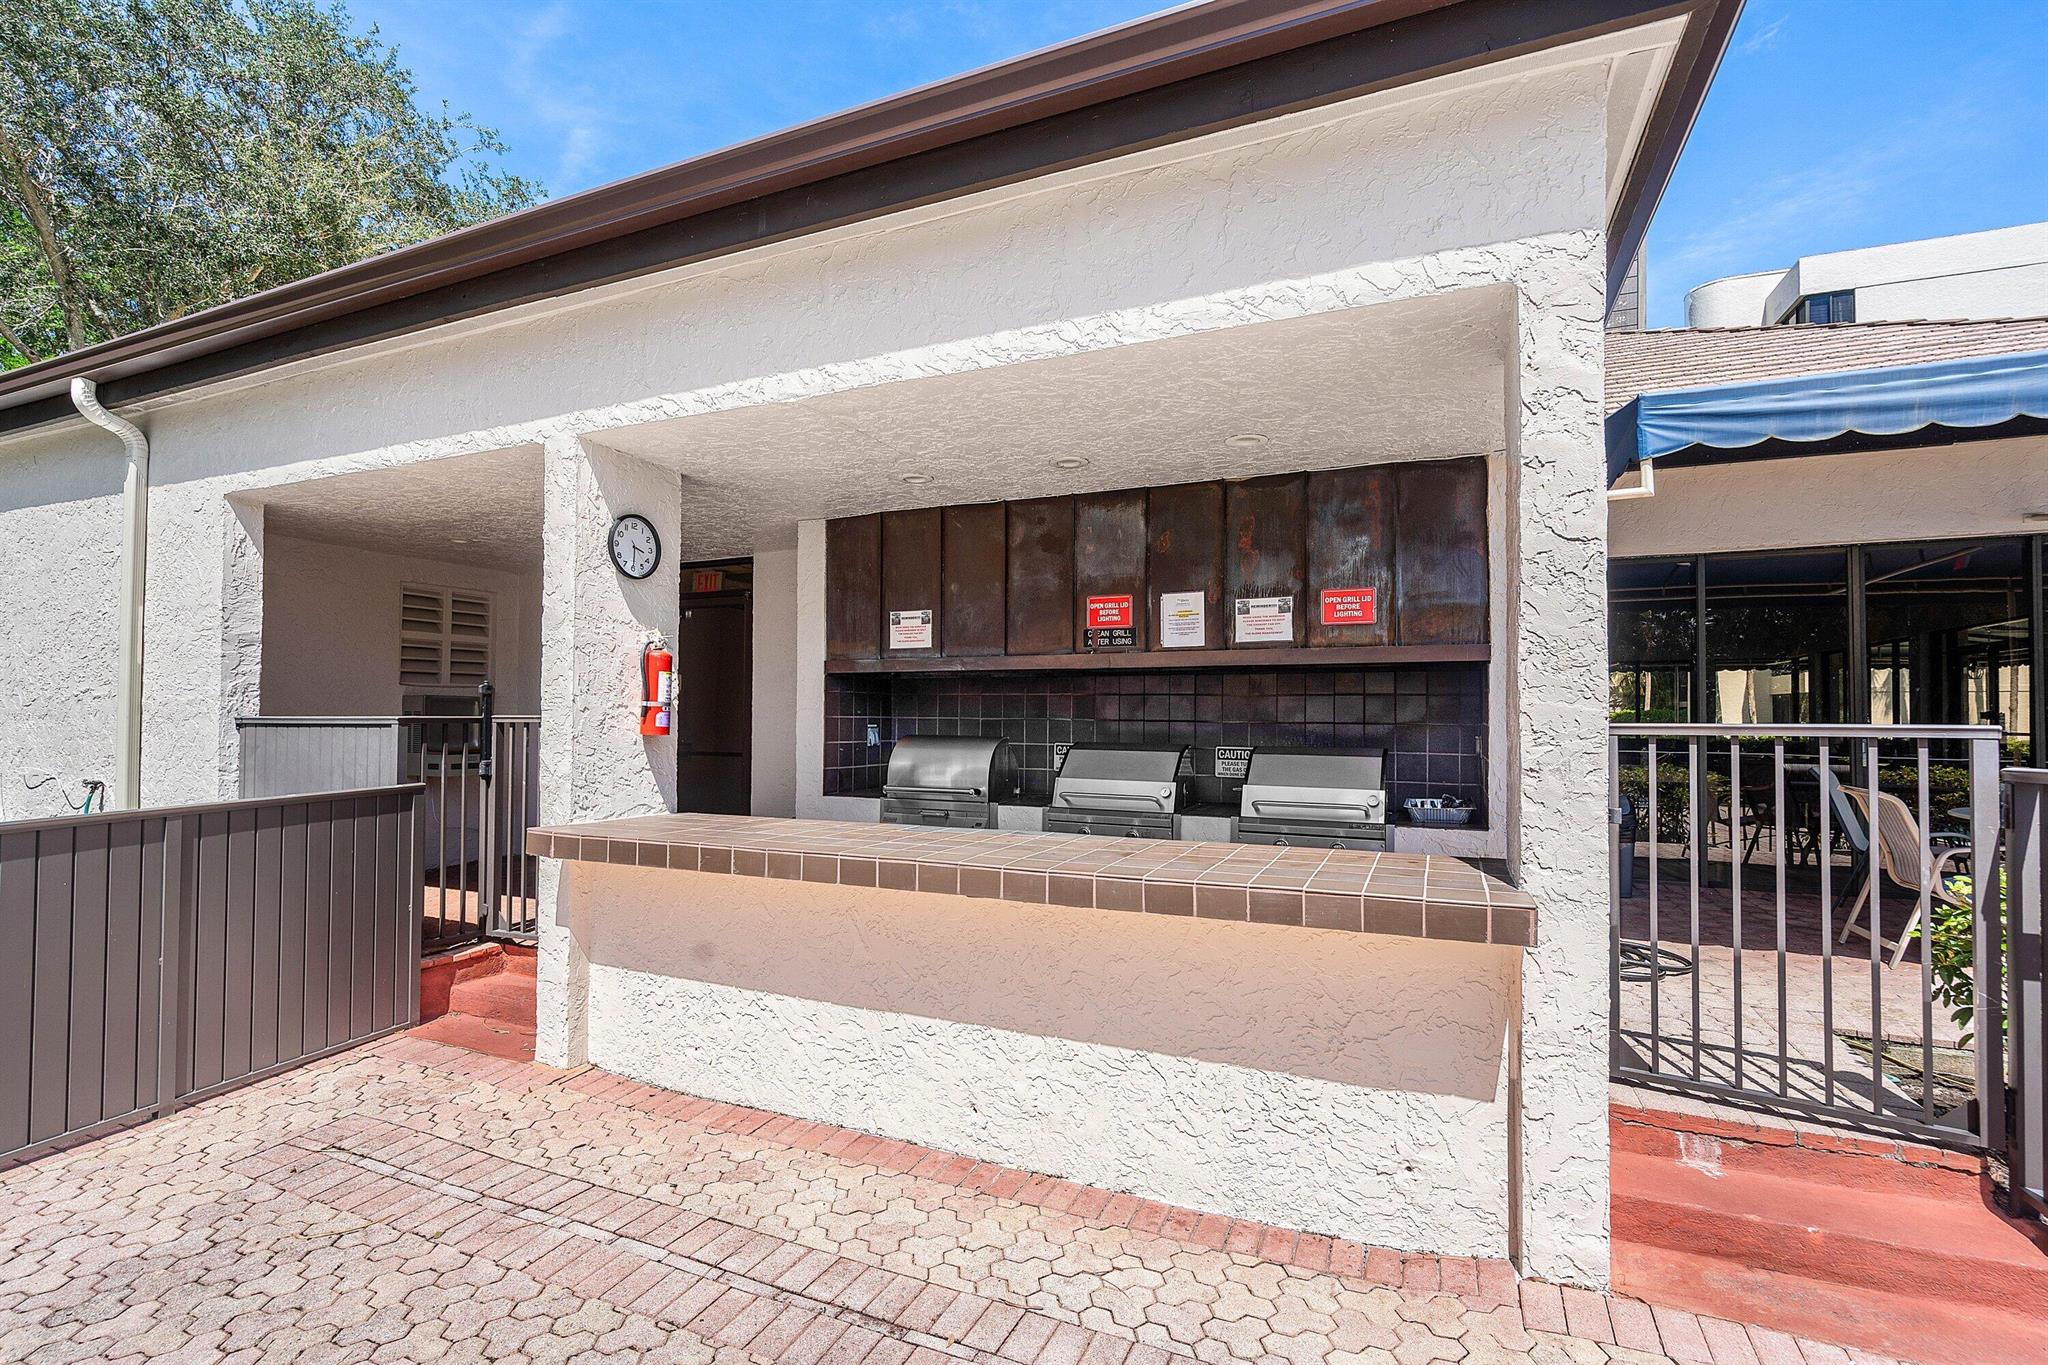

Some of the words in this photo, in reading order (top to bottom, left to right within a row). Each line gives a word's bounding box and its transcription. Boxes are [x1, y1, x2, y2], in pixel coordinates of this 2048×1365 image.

[631, 522, 638, 531] 12
[617, 530, 624, 538] 10
[645, 536, 651, 544] 2
[616, 551, 622, 559] 8
[630, 564, 636, 572] 6
[696, 572, 719, 592] EXIT
[1218, 750, 1250, 759] CAUTIO
